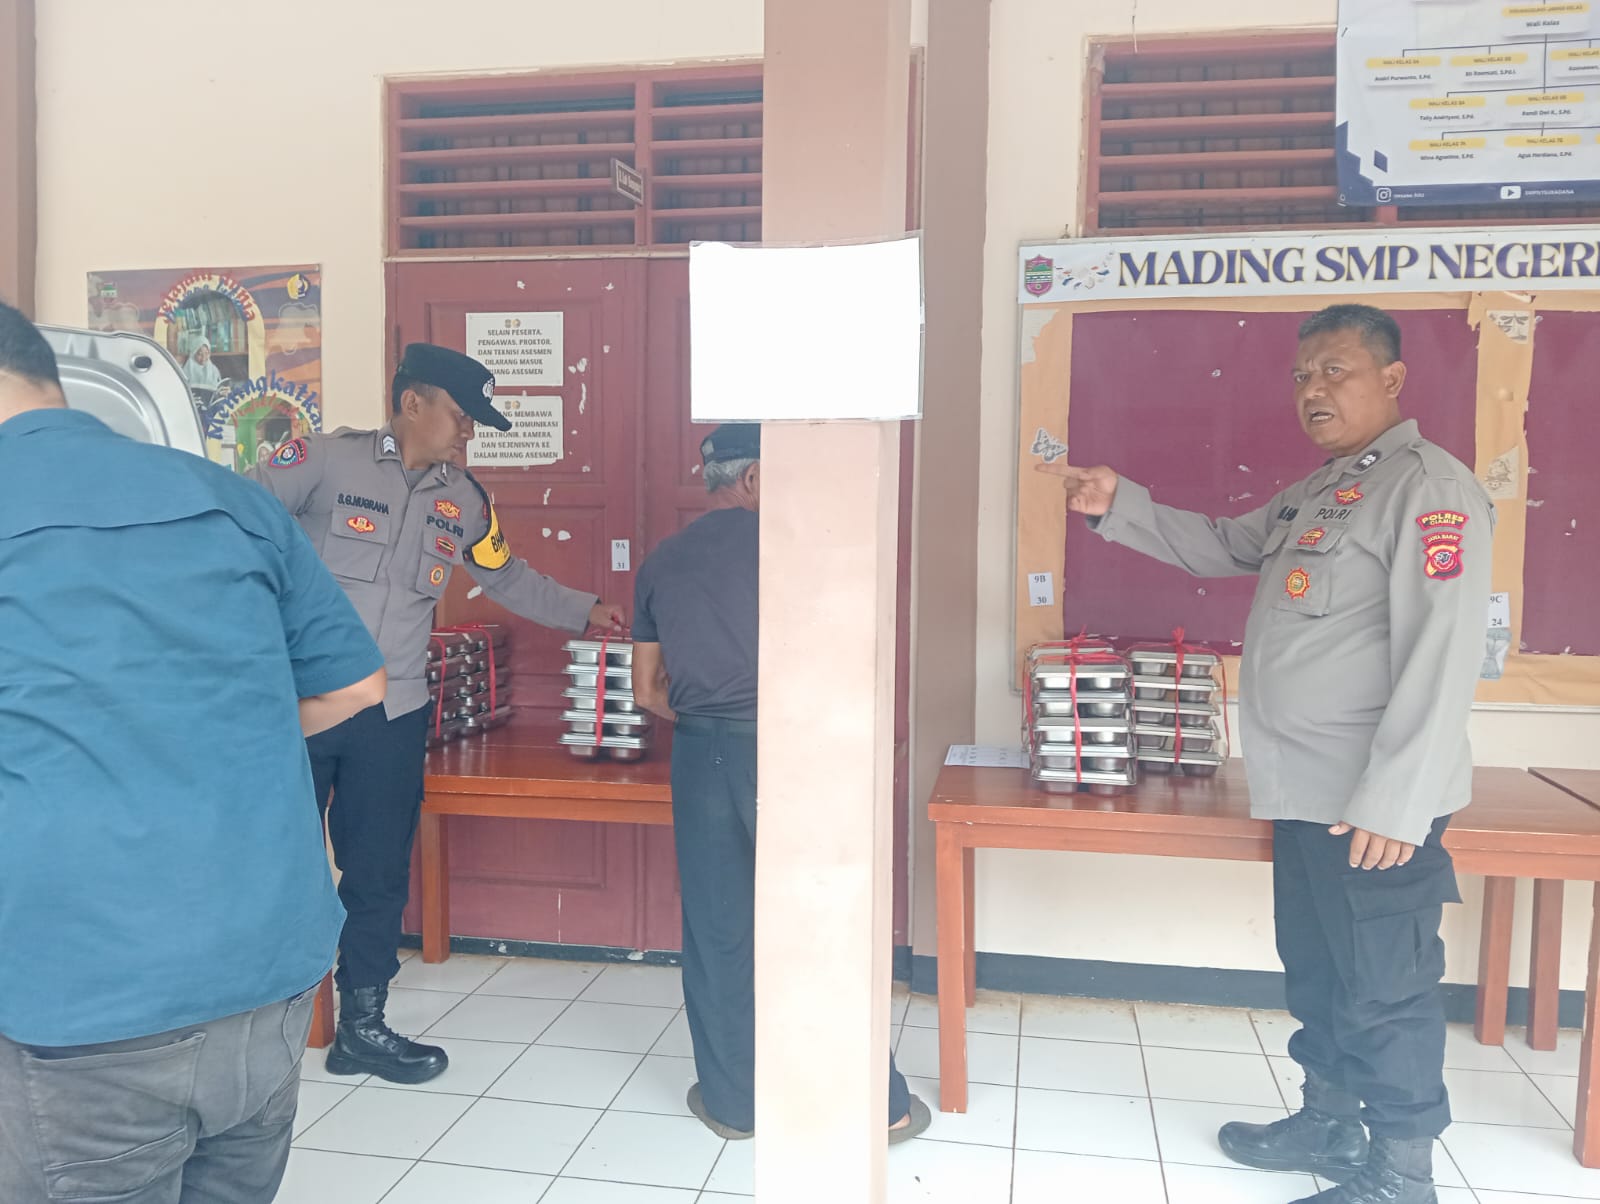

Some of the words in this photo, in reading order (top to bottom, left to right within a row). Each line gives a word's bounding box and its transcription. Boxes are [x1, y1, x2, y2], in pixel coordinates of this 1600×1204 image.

[1119, 247, 1305, 287] MADING
[1315, 244, 1419, 282] SMP
[485, 358, 518, 366] DILARANG
[490, 368, 510, 376] UANG
[497, 441, 540, 449] SEJENISNYA
[525, 451, 559, 459] ASESMEN
[1421, 512, 1465, 524] POLRES
[426, 515, 464, 538] POLRI
[1034, 575, 1046, 584] 9B
[1489, 595, 1503, 603] 9C
[1491, 618, 1502, 626] 24
